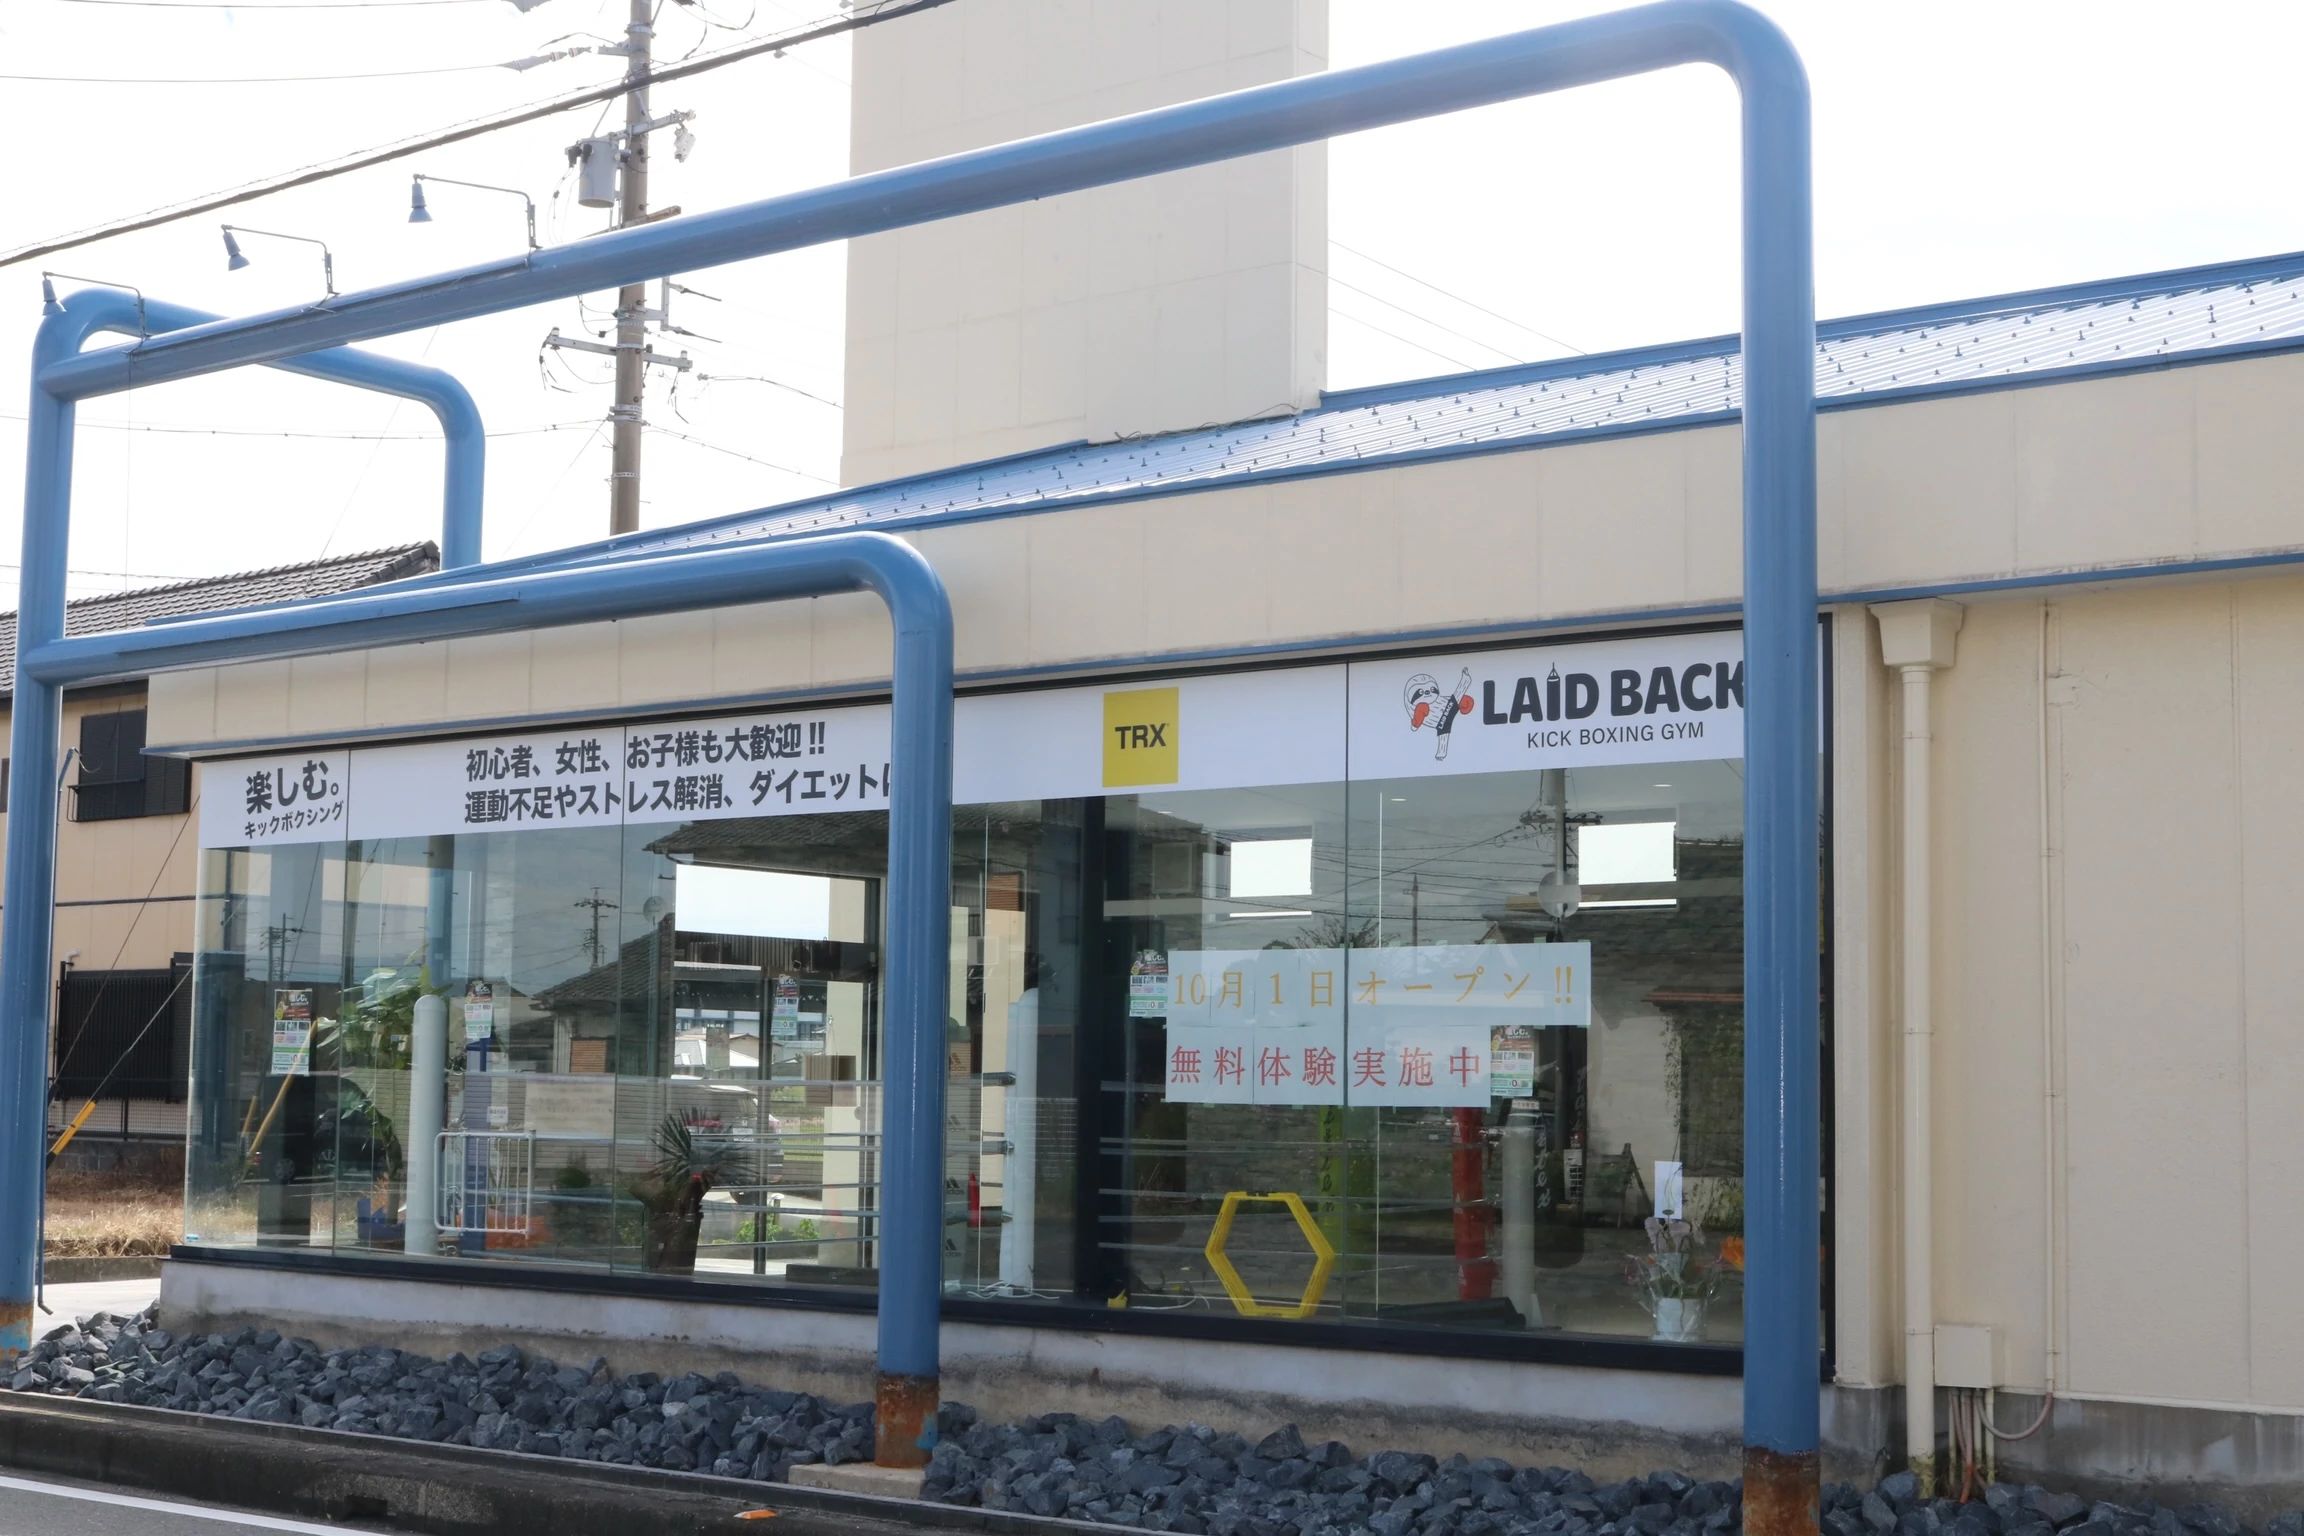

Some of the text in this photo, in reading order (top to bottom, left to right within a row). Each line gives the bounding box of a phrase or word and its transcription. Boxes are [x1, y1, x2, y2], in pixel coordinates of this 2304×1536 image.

[1483, 660, 1744, 725] LAID BACK
[1115, 723, 1166, 749] TRX
[1528, 721, 1704, 749] KICK BOXING GYM
[245, 760, 341, 814] 楽しむ。
[464, 762, 890, 824] 運動不足やストレス解消、ダイエット
[244, 800, 344, 839] キックボクシング
[1171, 1046, 1482, 1088] 無料体験実施中
